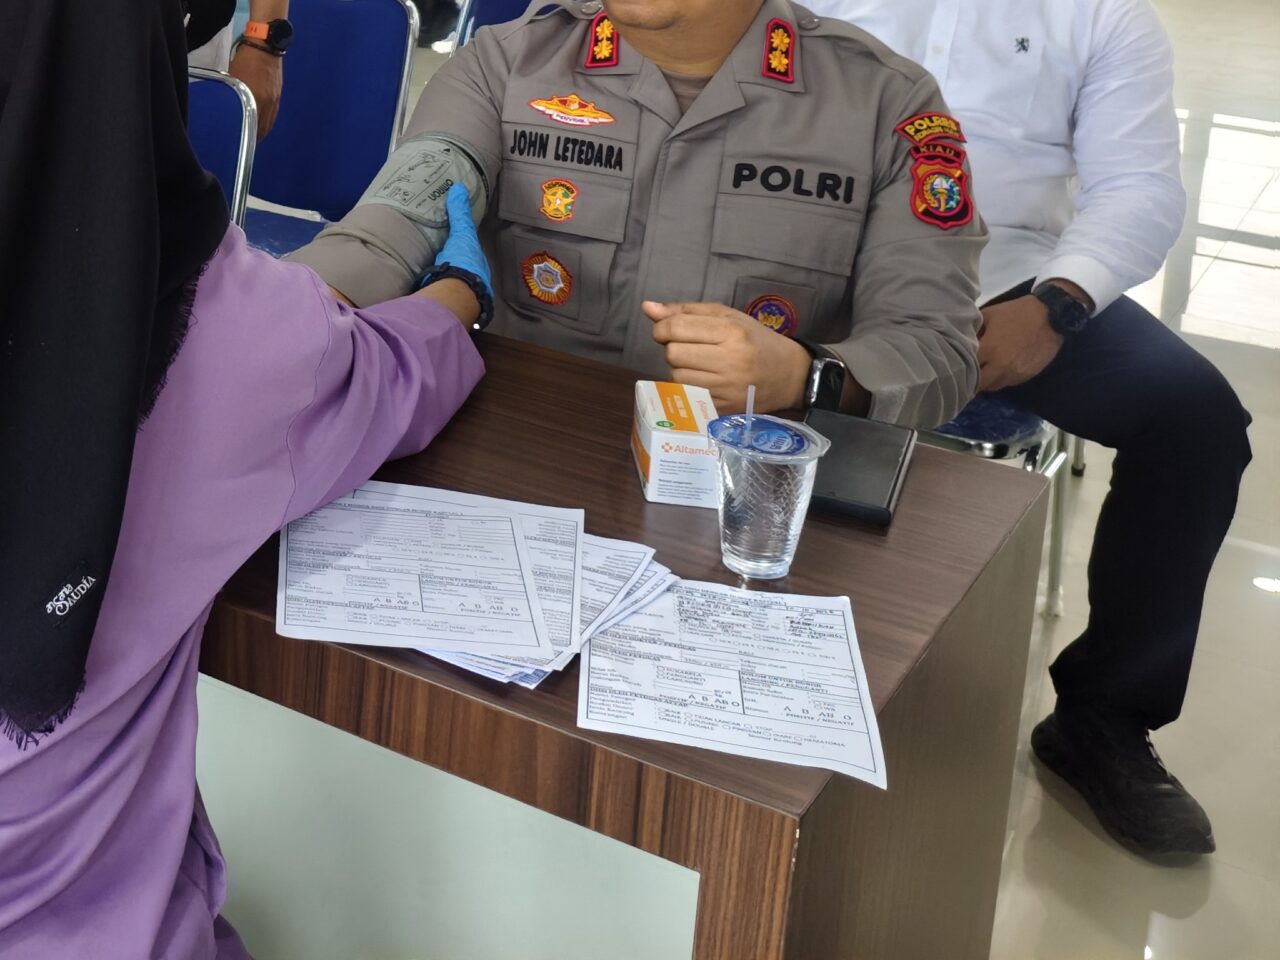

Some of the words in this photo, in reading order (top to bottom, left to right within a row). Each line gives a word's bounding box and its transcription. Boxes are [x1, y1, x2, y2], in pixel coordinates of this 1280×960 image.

[510, 128, 549, 159] JOHN
[553, 136, 623, 171] LETEDARA
[732, 163, 855, 204] POLRI
